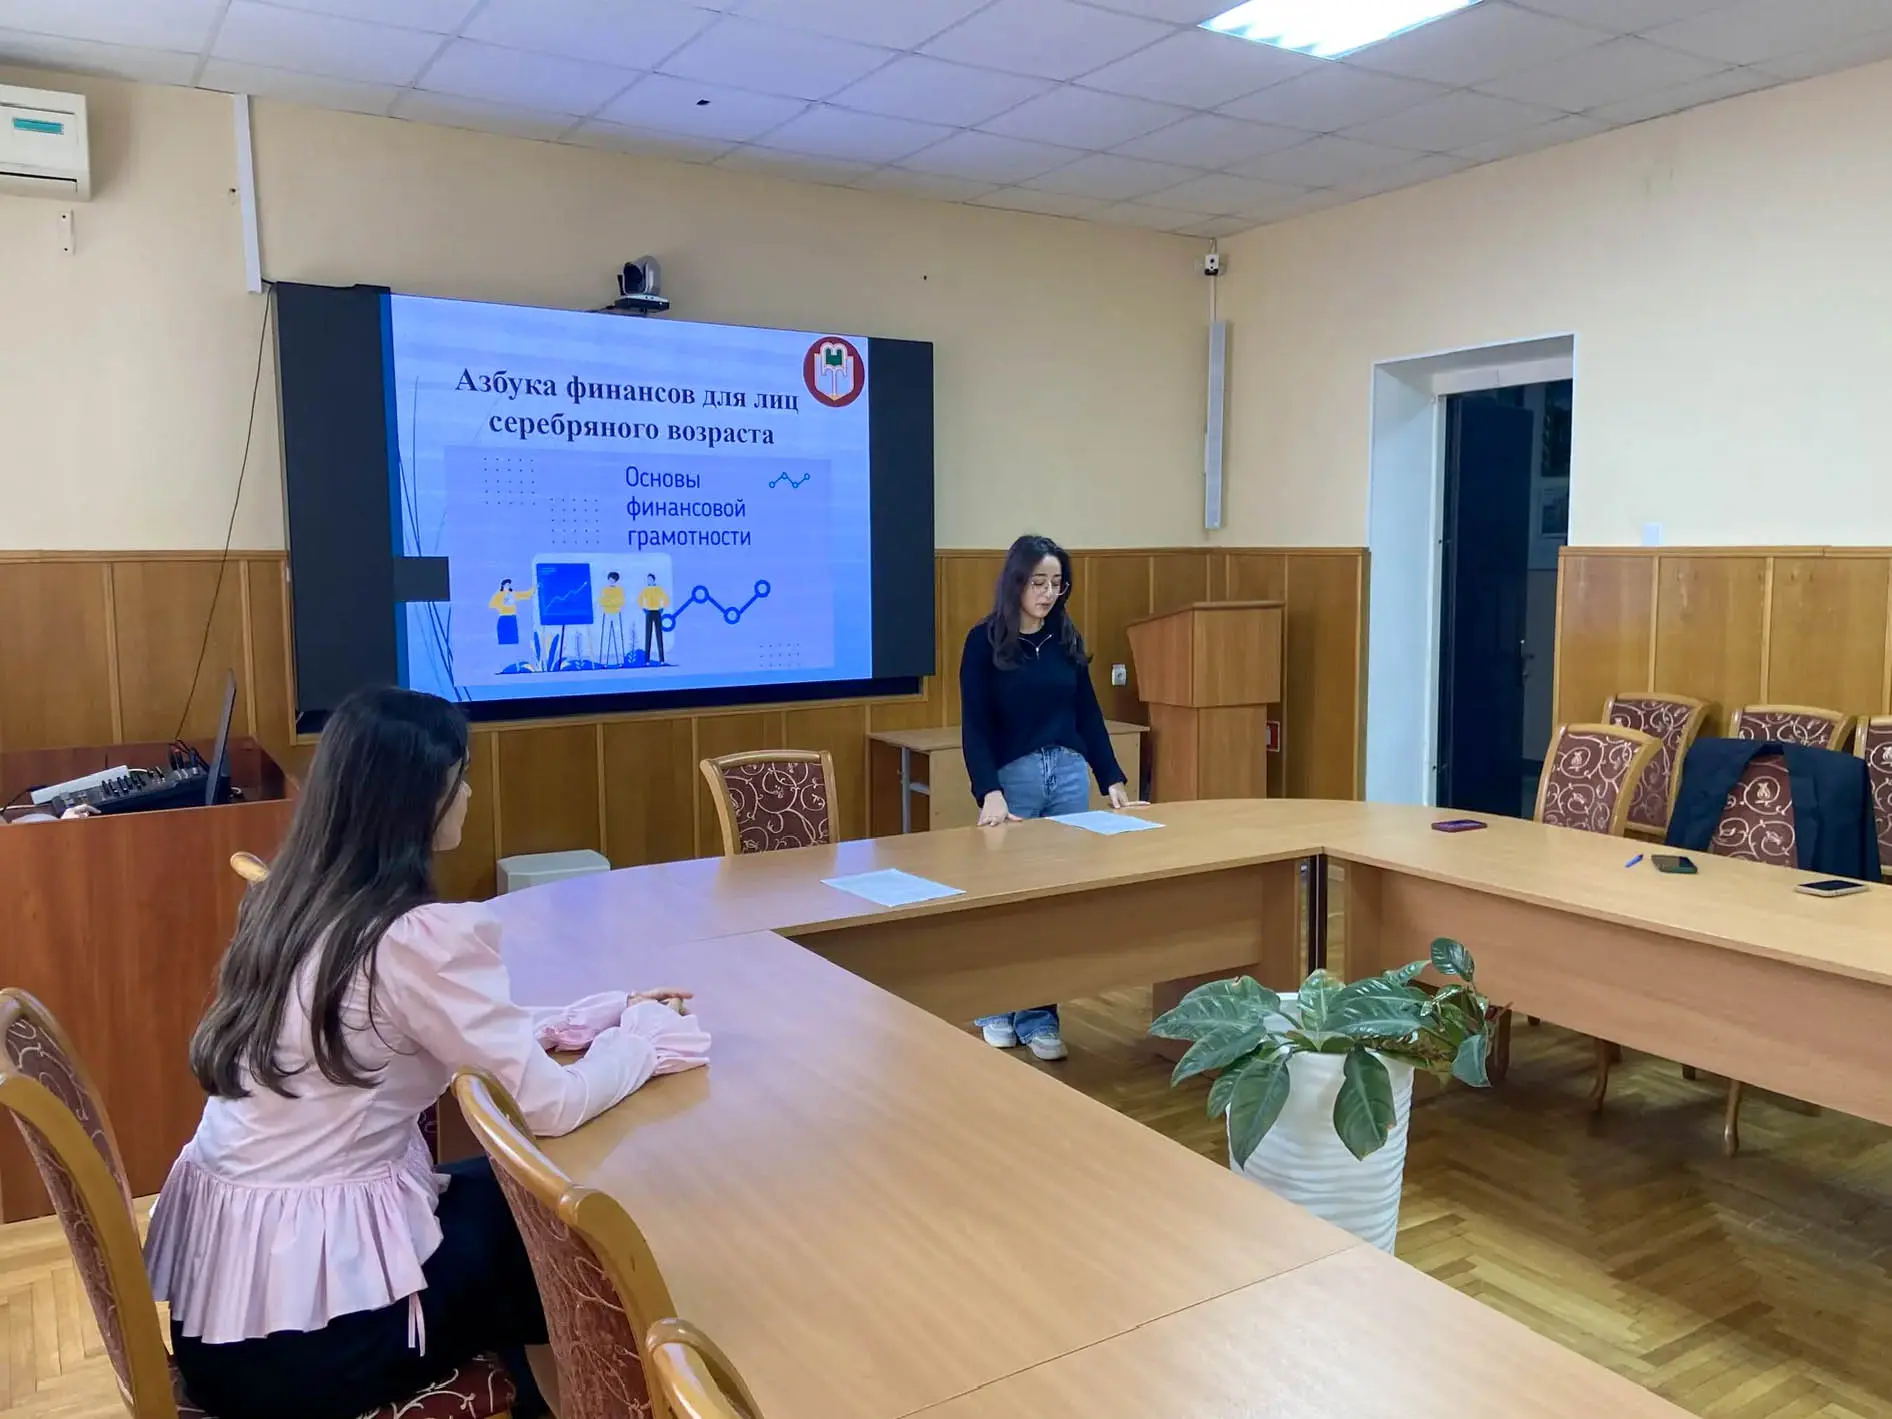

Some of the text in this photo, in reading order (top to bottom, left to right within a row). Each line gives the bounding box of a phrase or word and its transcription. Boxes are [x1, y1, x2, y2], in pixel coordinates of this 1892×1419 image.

[455, 368, 799, 414] Азбука финансов для лиц
[489, 412, 774, 448] серебряного возраста
[626, 466, 700, 488] Основы
[627, 495, 745, 521] финансовой
[628, 529, 751, 551] грамотности
